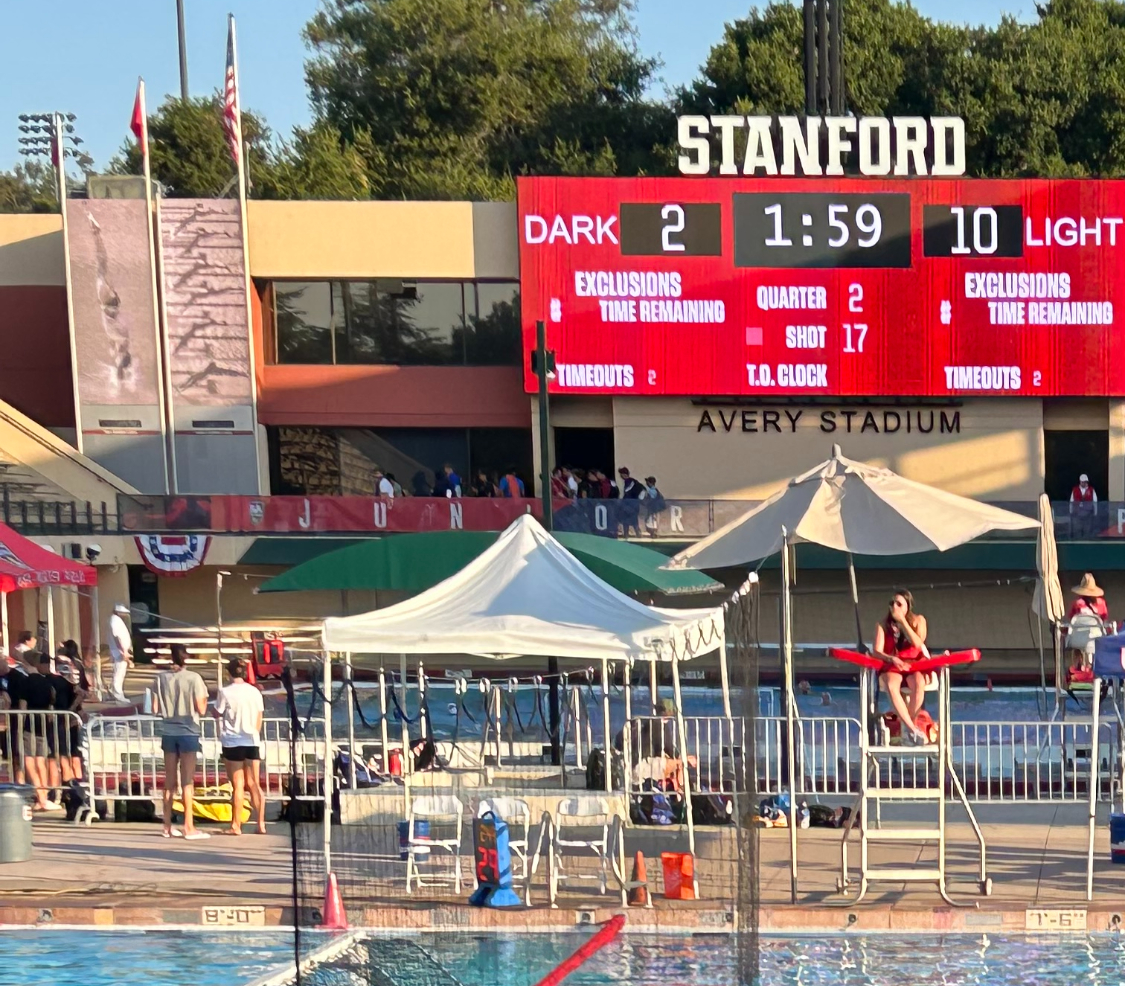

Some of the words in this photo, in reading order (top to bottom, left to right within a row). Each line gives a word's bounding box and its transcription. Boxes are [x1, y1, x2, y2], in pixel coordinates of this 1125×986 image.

[677, 115, 966, 176] STANFORD
[525, 215, 618, 244] DARK
[661, 204, 685, 251] 2
[764, 203, 882, 248] 1:59
[951, 207, 998, 253] 10
[1026, 217, 1123, 246] LIGHT
[575, 271, 682, 297] EXCLUSIONS
[965, 273, 1071, 298] EXCLUSIONS
[599, 299, 637, 322] TIME
[640, 300, 725, 323] REMAINING
[757, 286, 827, 310] QUARTER
[848, 283, 864, 313] 2
[988, 301, 1025, 324] TIME
[1029, 302, 1113, 325] REMAINING
[786, 326, 827, 348] SHOT
[842, 324, 868, 353] 17
[556, 364, 634, 387] TIMEOUTS
[747, 364, 775, 386] T.O.
[777, 364, 827, 387] CLOCK
[944, 366, 1021, 389] TIMEOUTS
[697, 410, 803, 433] AVERY
[820, 410, 961, 433] STADIUM
